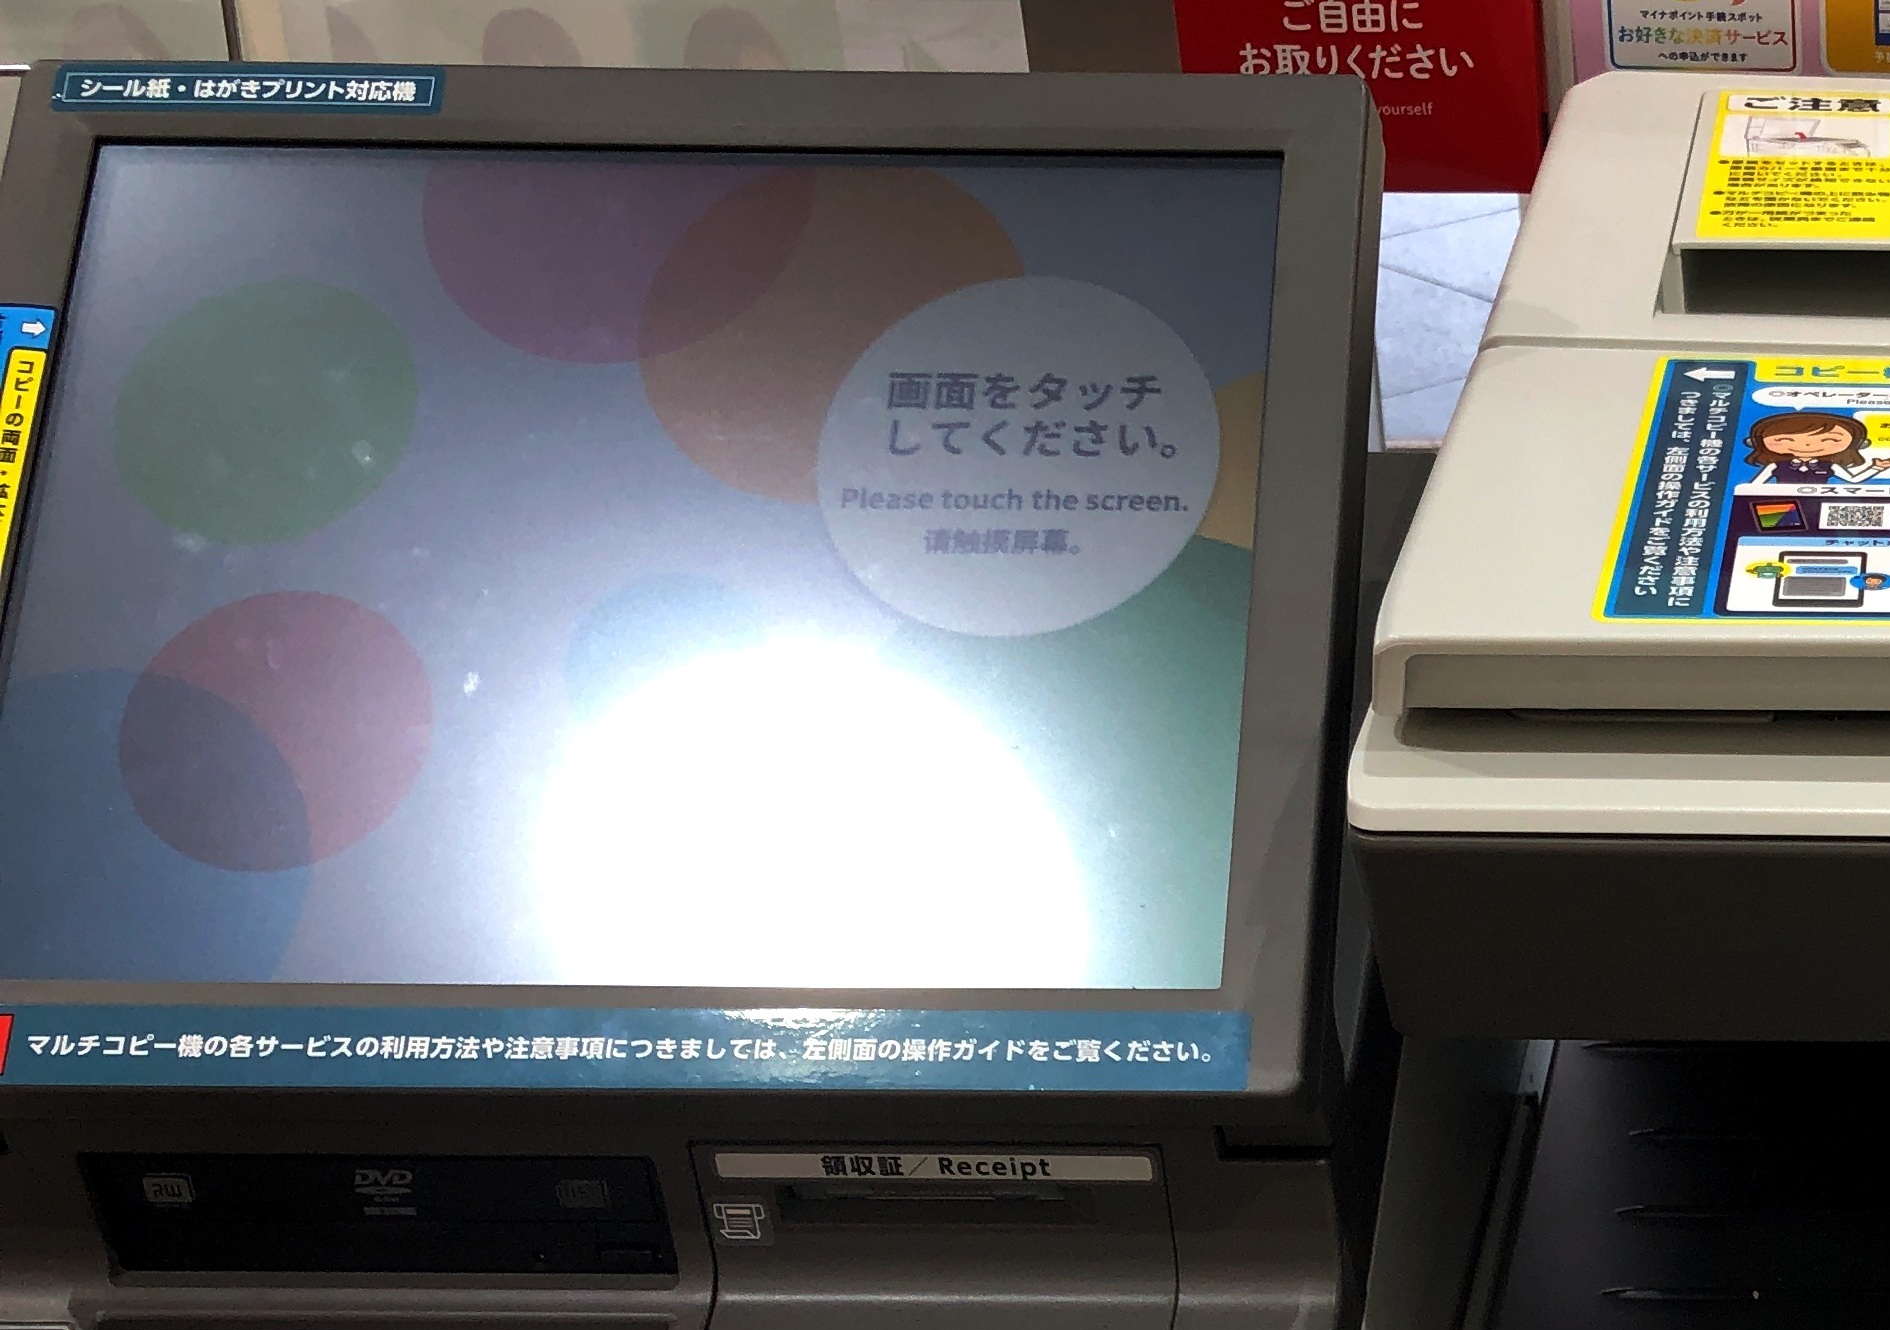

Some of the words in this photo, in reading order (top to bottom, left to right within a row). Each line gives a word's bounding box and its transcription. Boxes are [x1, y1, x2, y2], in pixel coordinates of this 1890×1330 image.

[1283, 0, 1424, 32] ご自由に
[1618, 25, 1788, 46] お好きな決済サービス
[1238, 43, 1475, 79] お取りください
[80, 77, 417, 104] シール紙・はがきプリント対応機
[1744, 96, 1882, 112] ご注意
[887, 372, 1163, 411] 画面をタッチ
[887, 418, 1177, 459] してください。
[840, 488, 934, 510] Please
[941, 488, 1024, 510] touch
[1031, 489, 1079, 511] the
[1085, 493, 1189, 512] screen.
[354, 1169, 414, 1188] DVD
[939, 1157, 1052, 1181] Receipt
